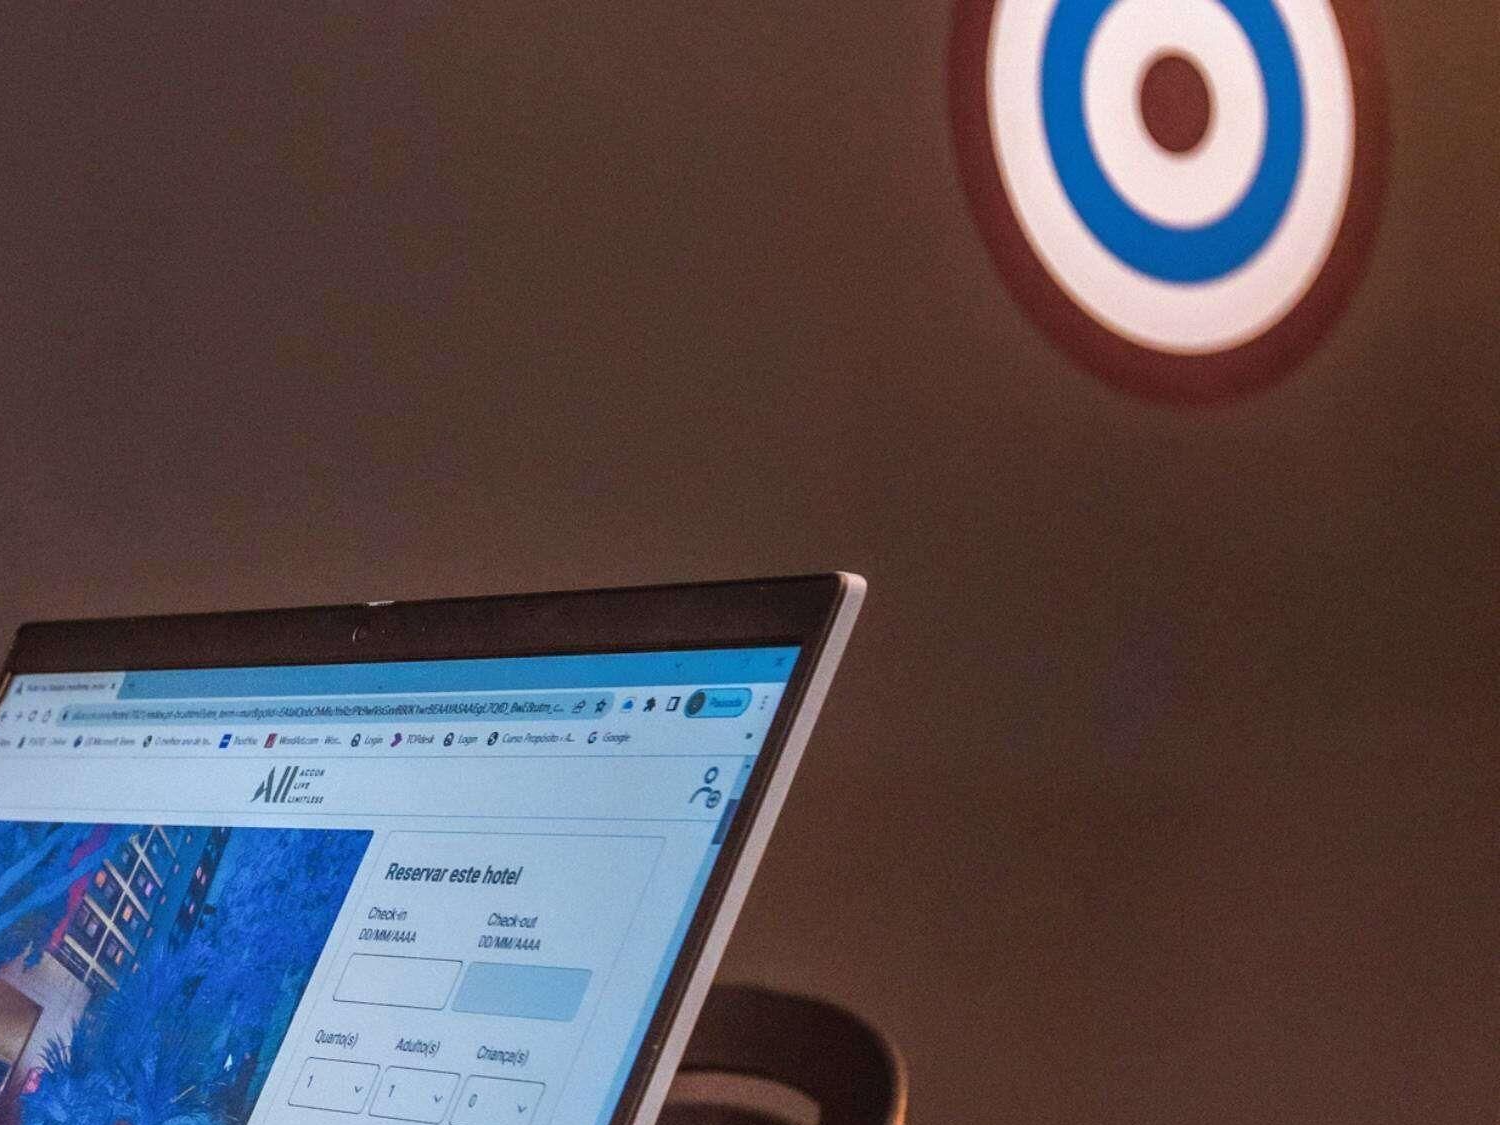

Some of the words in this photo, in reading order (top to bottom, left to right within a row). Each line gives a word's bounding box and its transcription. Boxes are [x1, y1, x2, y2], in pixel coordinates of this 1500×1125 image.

[603, 732, 631, 744] Google
[385, 862, 449, 883] Reservar
[450, 865, 480, 884] este
[482, 865, 524, 885] hotel
[367, 906, 408, 921] Check-in
[487, 912, 539, 929] Check-out
[314, 1029, 359, 1049] Quarto(s)
